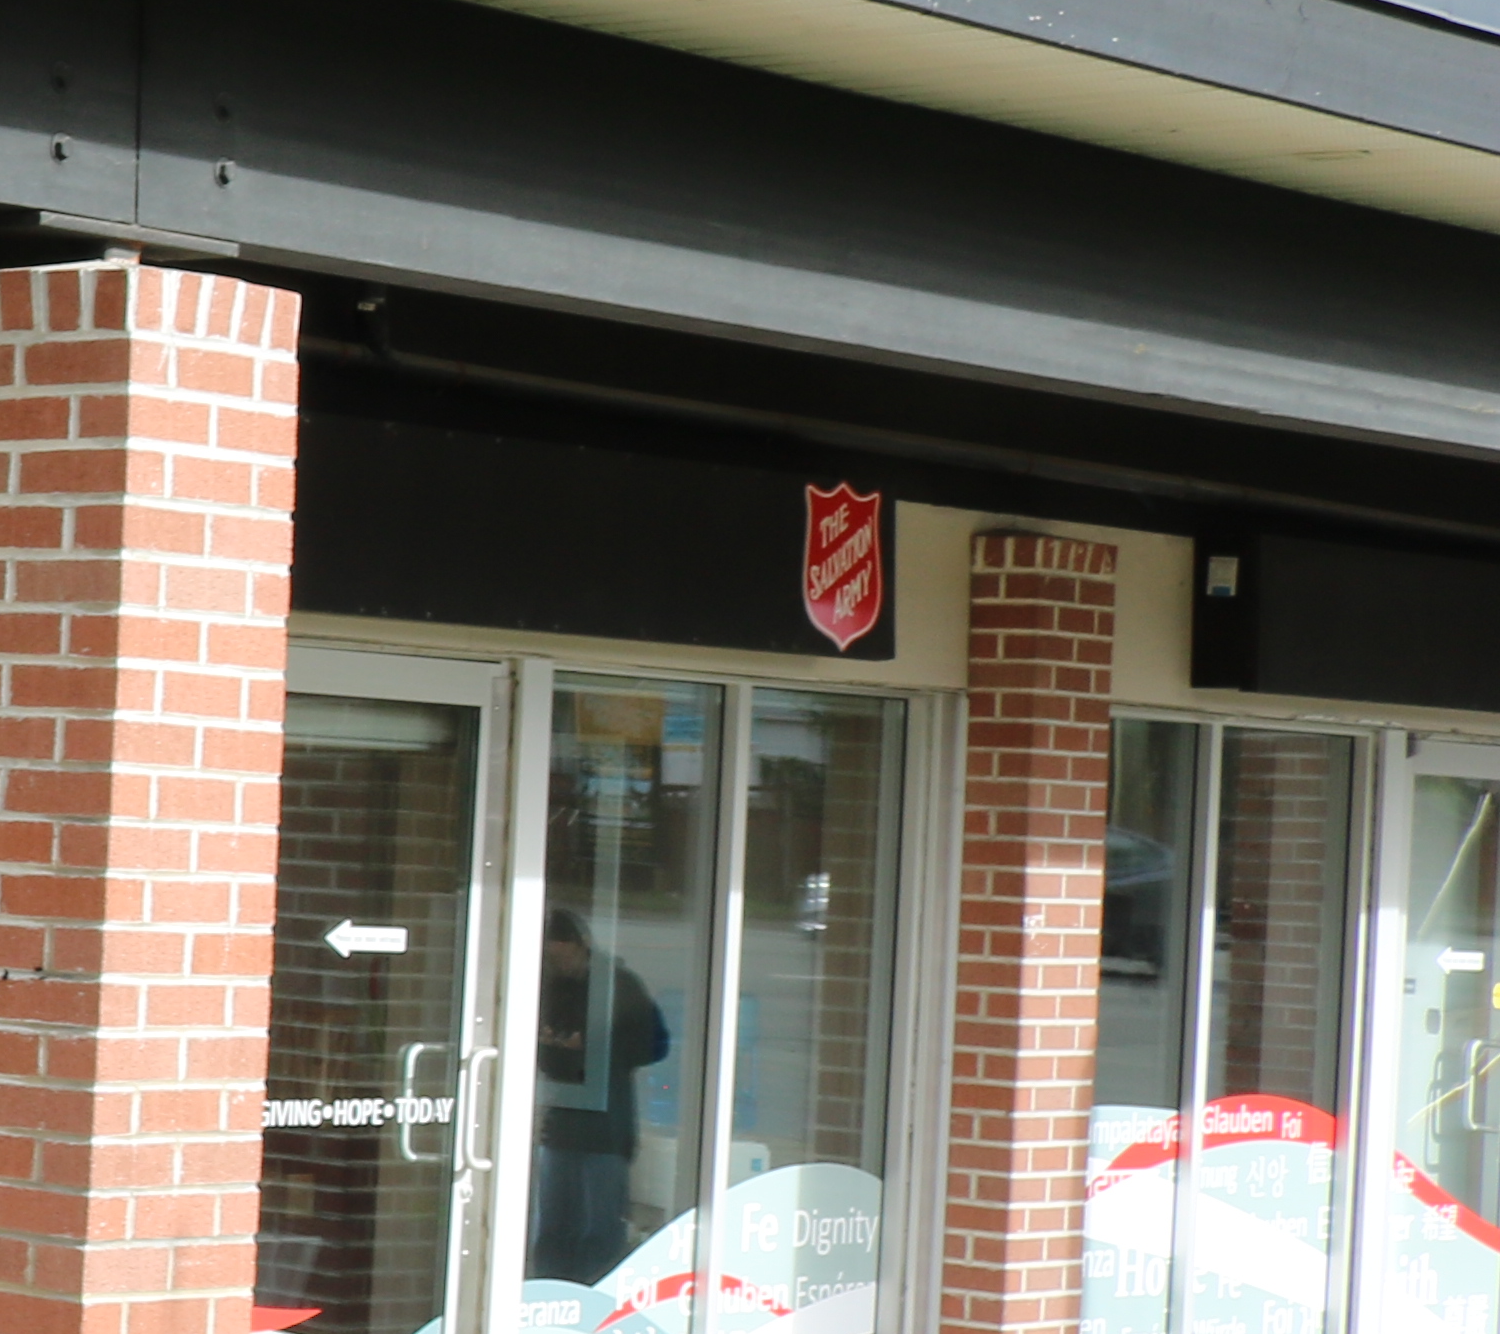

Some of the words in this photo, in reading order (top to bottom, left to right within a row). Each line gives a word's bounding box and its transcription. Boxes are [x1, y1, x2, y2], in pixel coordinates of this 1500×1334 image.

[820, 503, 850, 548] THE
[810, 517, 873, 601] SALVATION
[833, 560, 872, 624] ARMY
[333, 1098, 385, 1126] HOPE
[394, 1098, 454, 1124] TODAY
[1202, 1103, 1274, 1134] Glauben
[1281, 1111, 1303, 1139] Foi
[741, 1203, 779, 1252] Fe
[792, 1207, 879, 1255] Dignity
